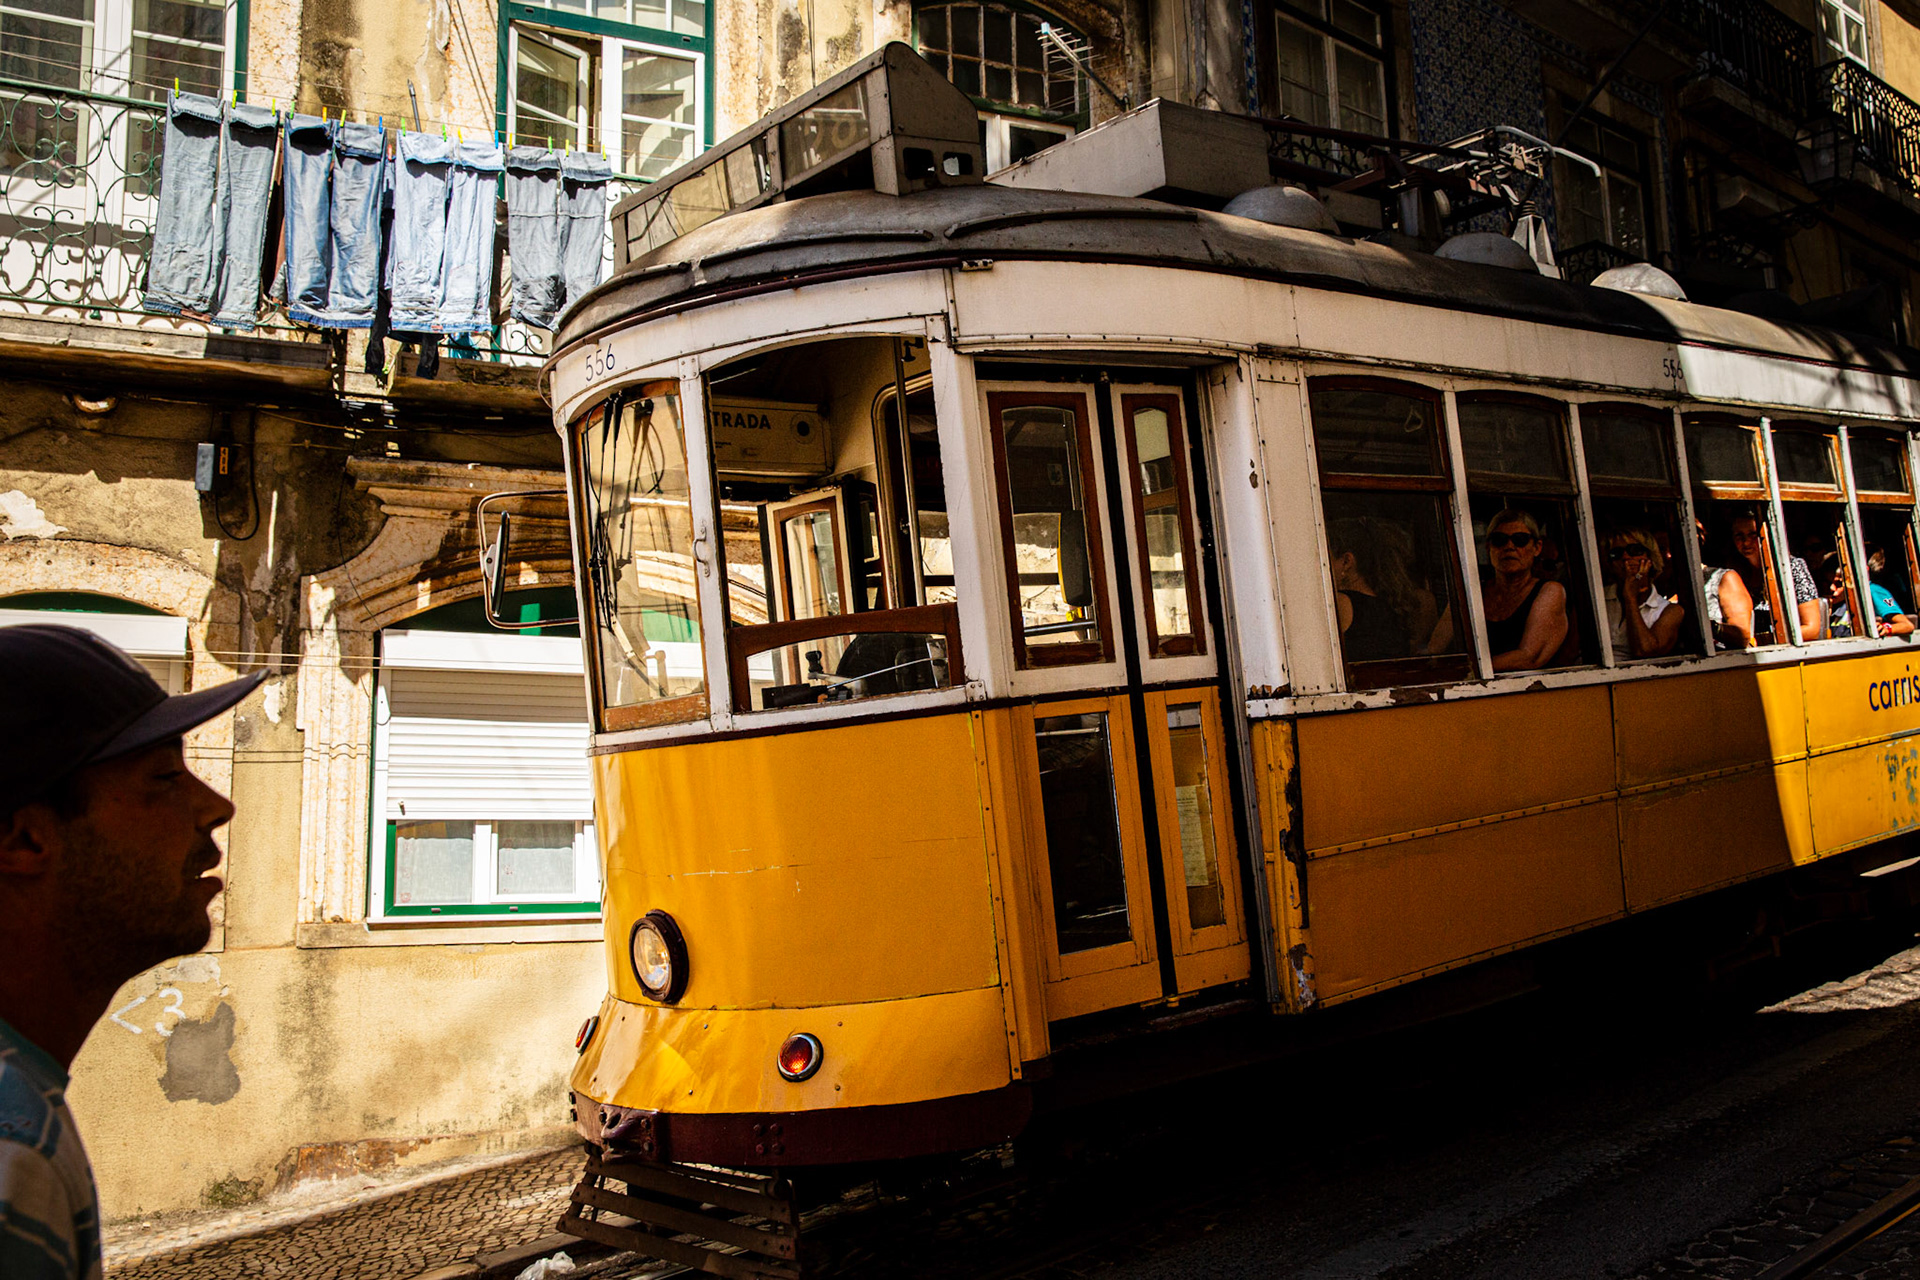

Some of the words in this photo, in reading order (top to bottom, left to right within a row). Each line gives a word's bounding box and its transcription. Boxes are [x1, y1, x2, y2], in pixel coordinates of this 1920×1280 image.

[586, 343, 615, 382] 556
[1663, 358, 1684, 379] 556
[1868, 663, 1920, 712] carris
